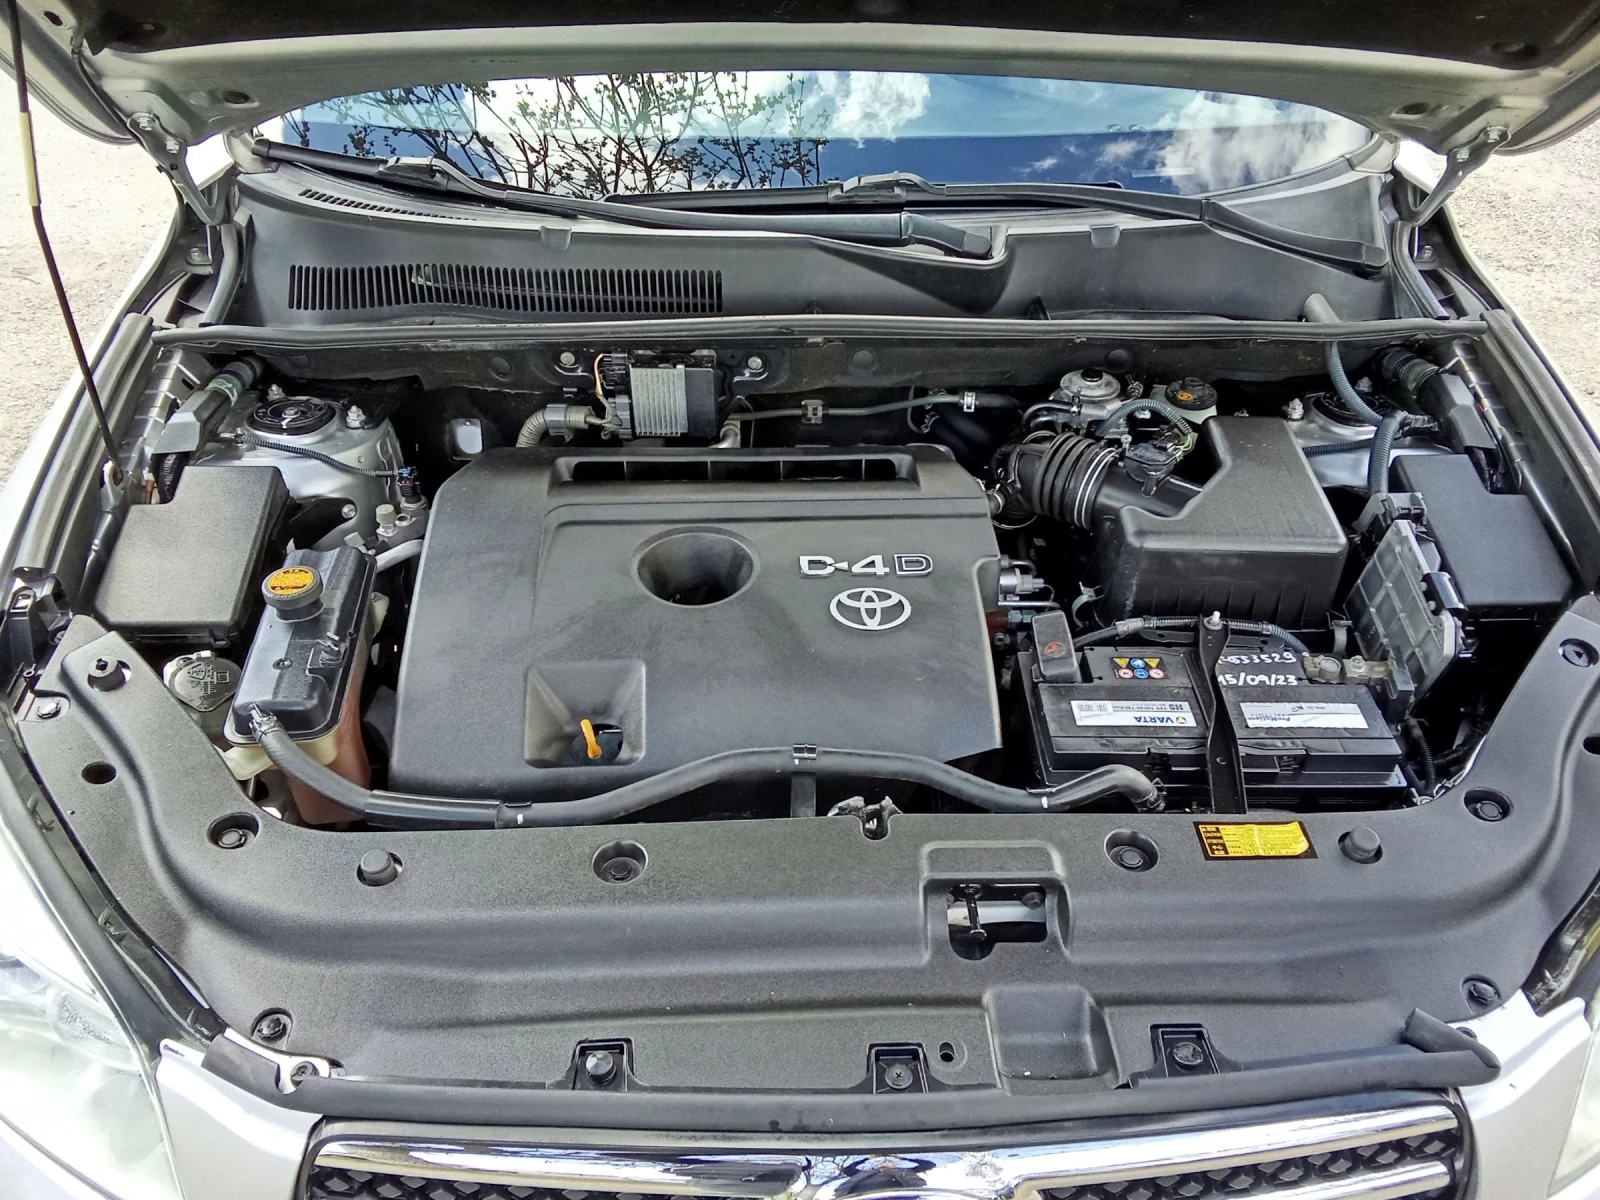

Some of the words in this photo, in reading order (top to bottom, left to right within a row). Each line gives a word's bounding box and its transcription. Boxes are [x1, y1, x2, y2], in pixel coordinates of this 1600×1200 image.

[799, 553, 933, 577] D-4D
[1217, 672, 1299, 686] 15/09/23
[1133, 716, 1175, 724] VARTA
